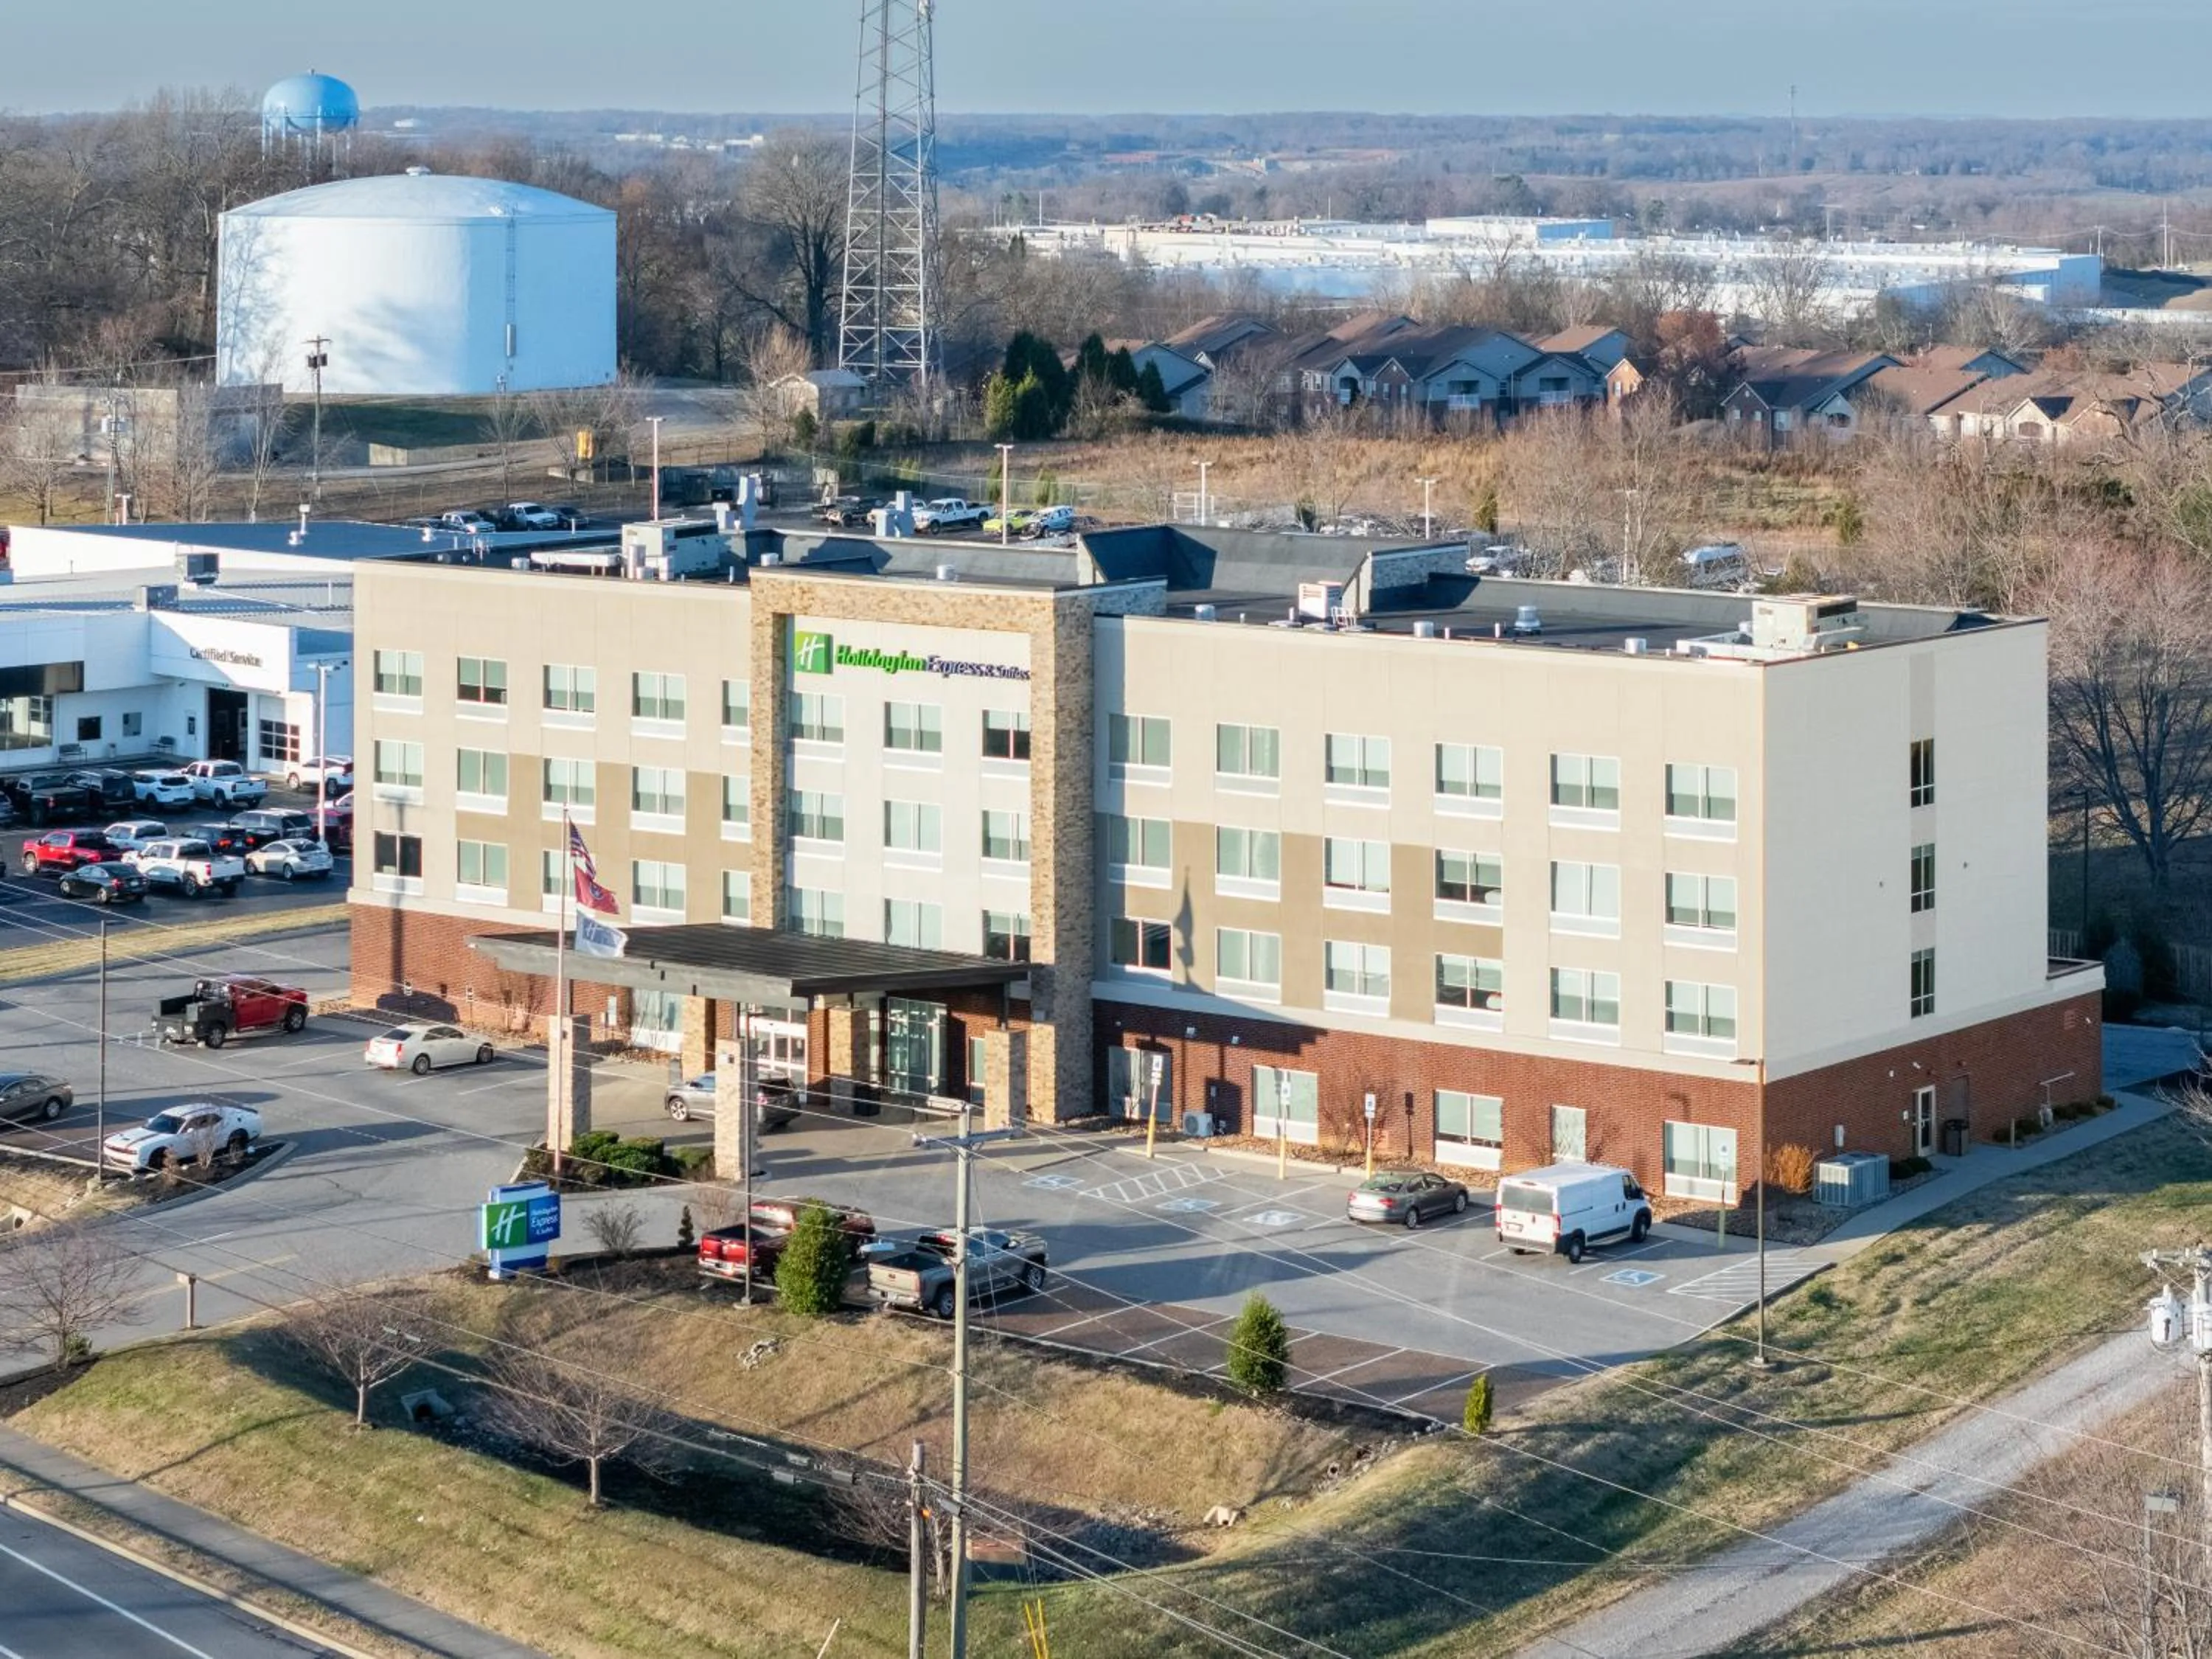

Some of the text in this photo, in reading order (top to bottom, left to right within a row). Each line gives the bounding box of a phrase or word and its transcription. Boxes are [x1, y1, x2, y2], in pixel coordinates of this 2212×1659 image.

[189, 647, 226, 662] Certified
[837, 644, 900, 674] Holiday
[899, 650, 927, 671] Inn
[928, 654, 984, 678] Express
[490, 1205, 527, 1244] H
